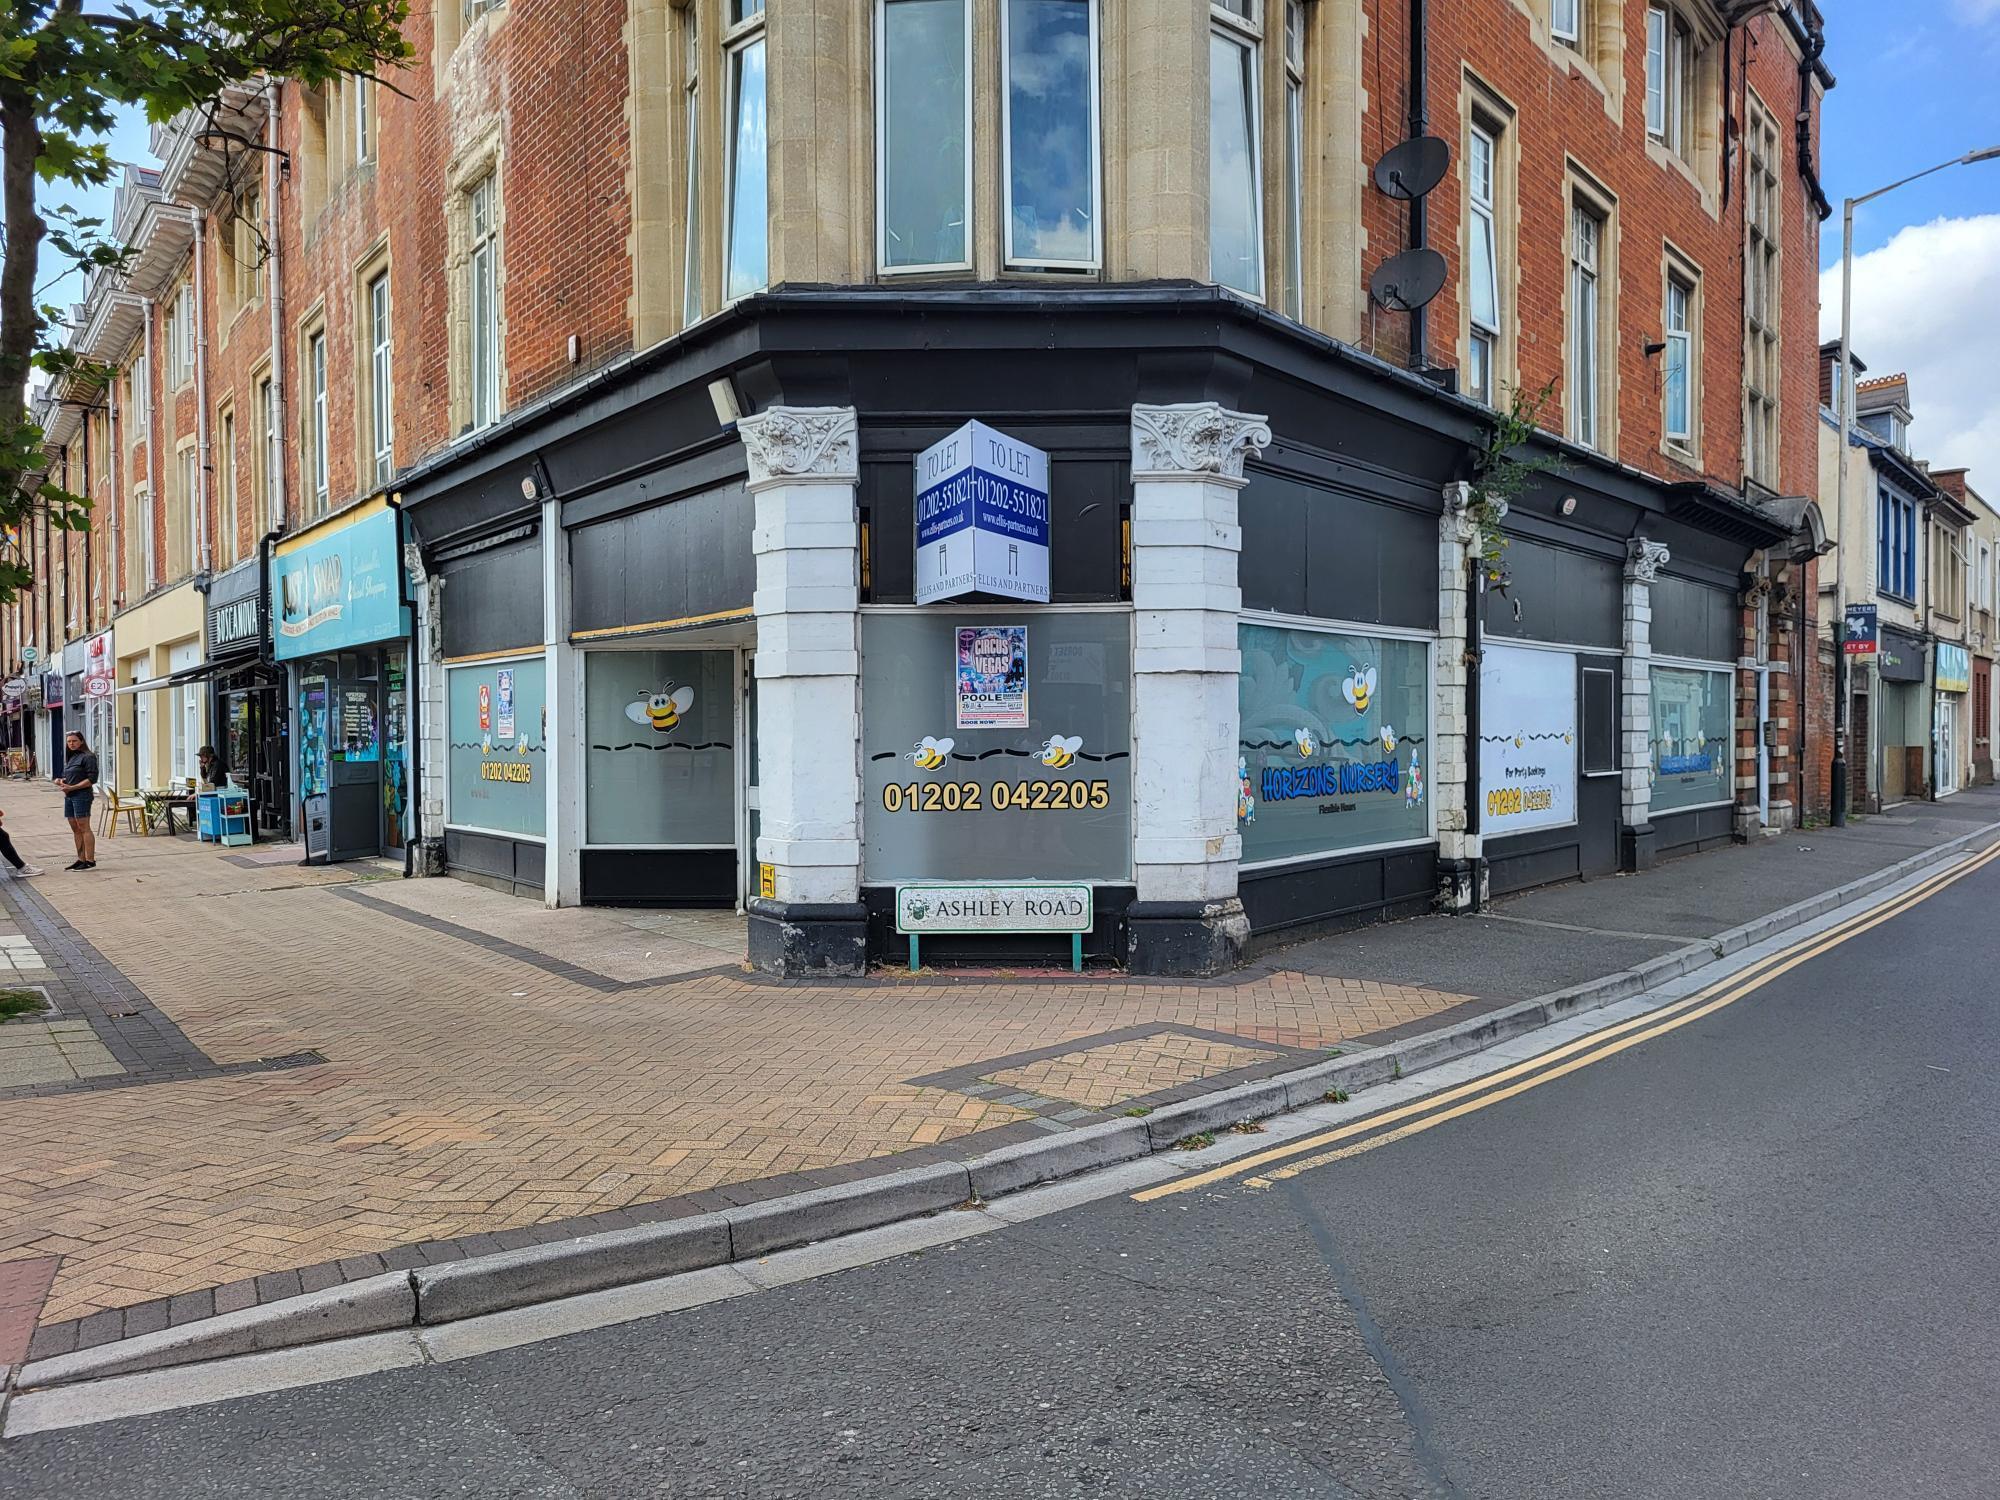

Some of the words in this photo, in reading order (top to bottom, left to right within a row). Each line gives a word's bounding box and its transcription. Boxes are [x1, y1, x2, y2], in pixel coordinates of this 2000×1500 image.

[927, 454, 939, 480] TO
[940, 441, 959, 472] LET
[989, 439, 1006, 469] TO
[1008, 448, 1031, 478] LET
[918, 474, 971, 523] 01202-551821
[977, 475, 1047, 522] 01202-551821
[921, 510, 965, 538] www.ellis-partners.co.uk
[982, 511, 1039, 537] www.ellis-partners.co.uk
[918, 583, 933, 598] ELLIS
[933, 580, 945, 592] AND
[945, 572, 974, 589] PARTNERS
[978, 573, 997, 586] ELLIS
[997, 578, 1013, 590] AND
[1015, 579, 1048, 595] PARTNERS
[216, 599, 258, 644] BOSCANOVA
[974, 639, 1009, 655] CIRCUS
[975, 656, 1009, 675] VEGAS
[961, 694, 1003, 702] POOLE
[481, 761, 503, 781] 01202
[503, 762, 531, 783] 042205
[1261, 763, 1339, 802] HORIZONS
[1339, 758, 1400, 795] NURSERY
[883, 781, 982, 812] 01202
[990, 779, 1110, 812] 042205
[1318, 803, 1340, 814] Flexible
[1340, 803, 1356, 812] Hours
[1487, 787, 1522, 816] 01202
[936, 900, 1015, 917] ASHLEY
[1025, 900, 1083, 916] ROAD
